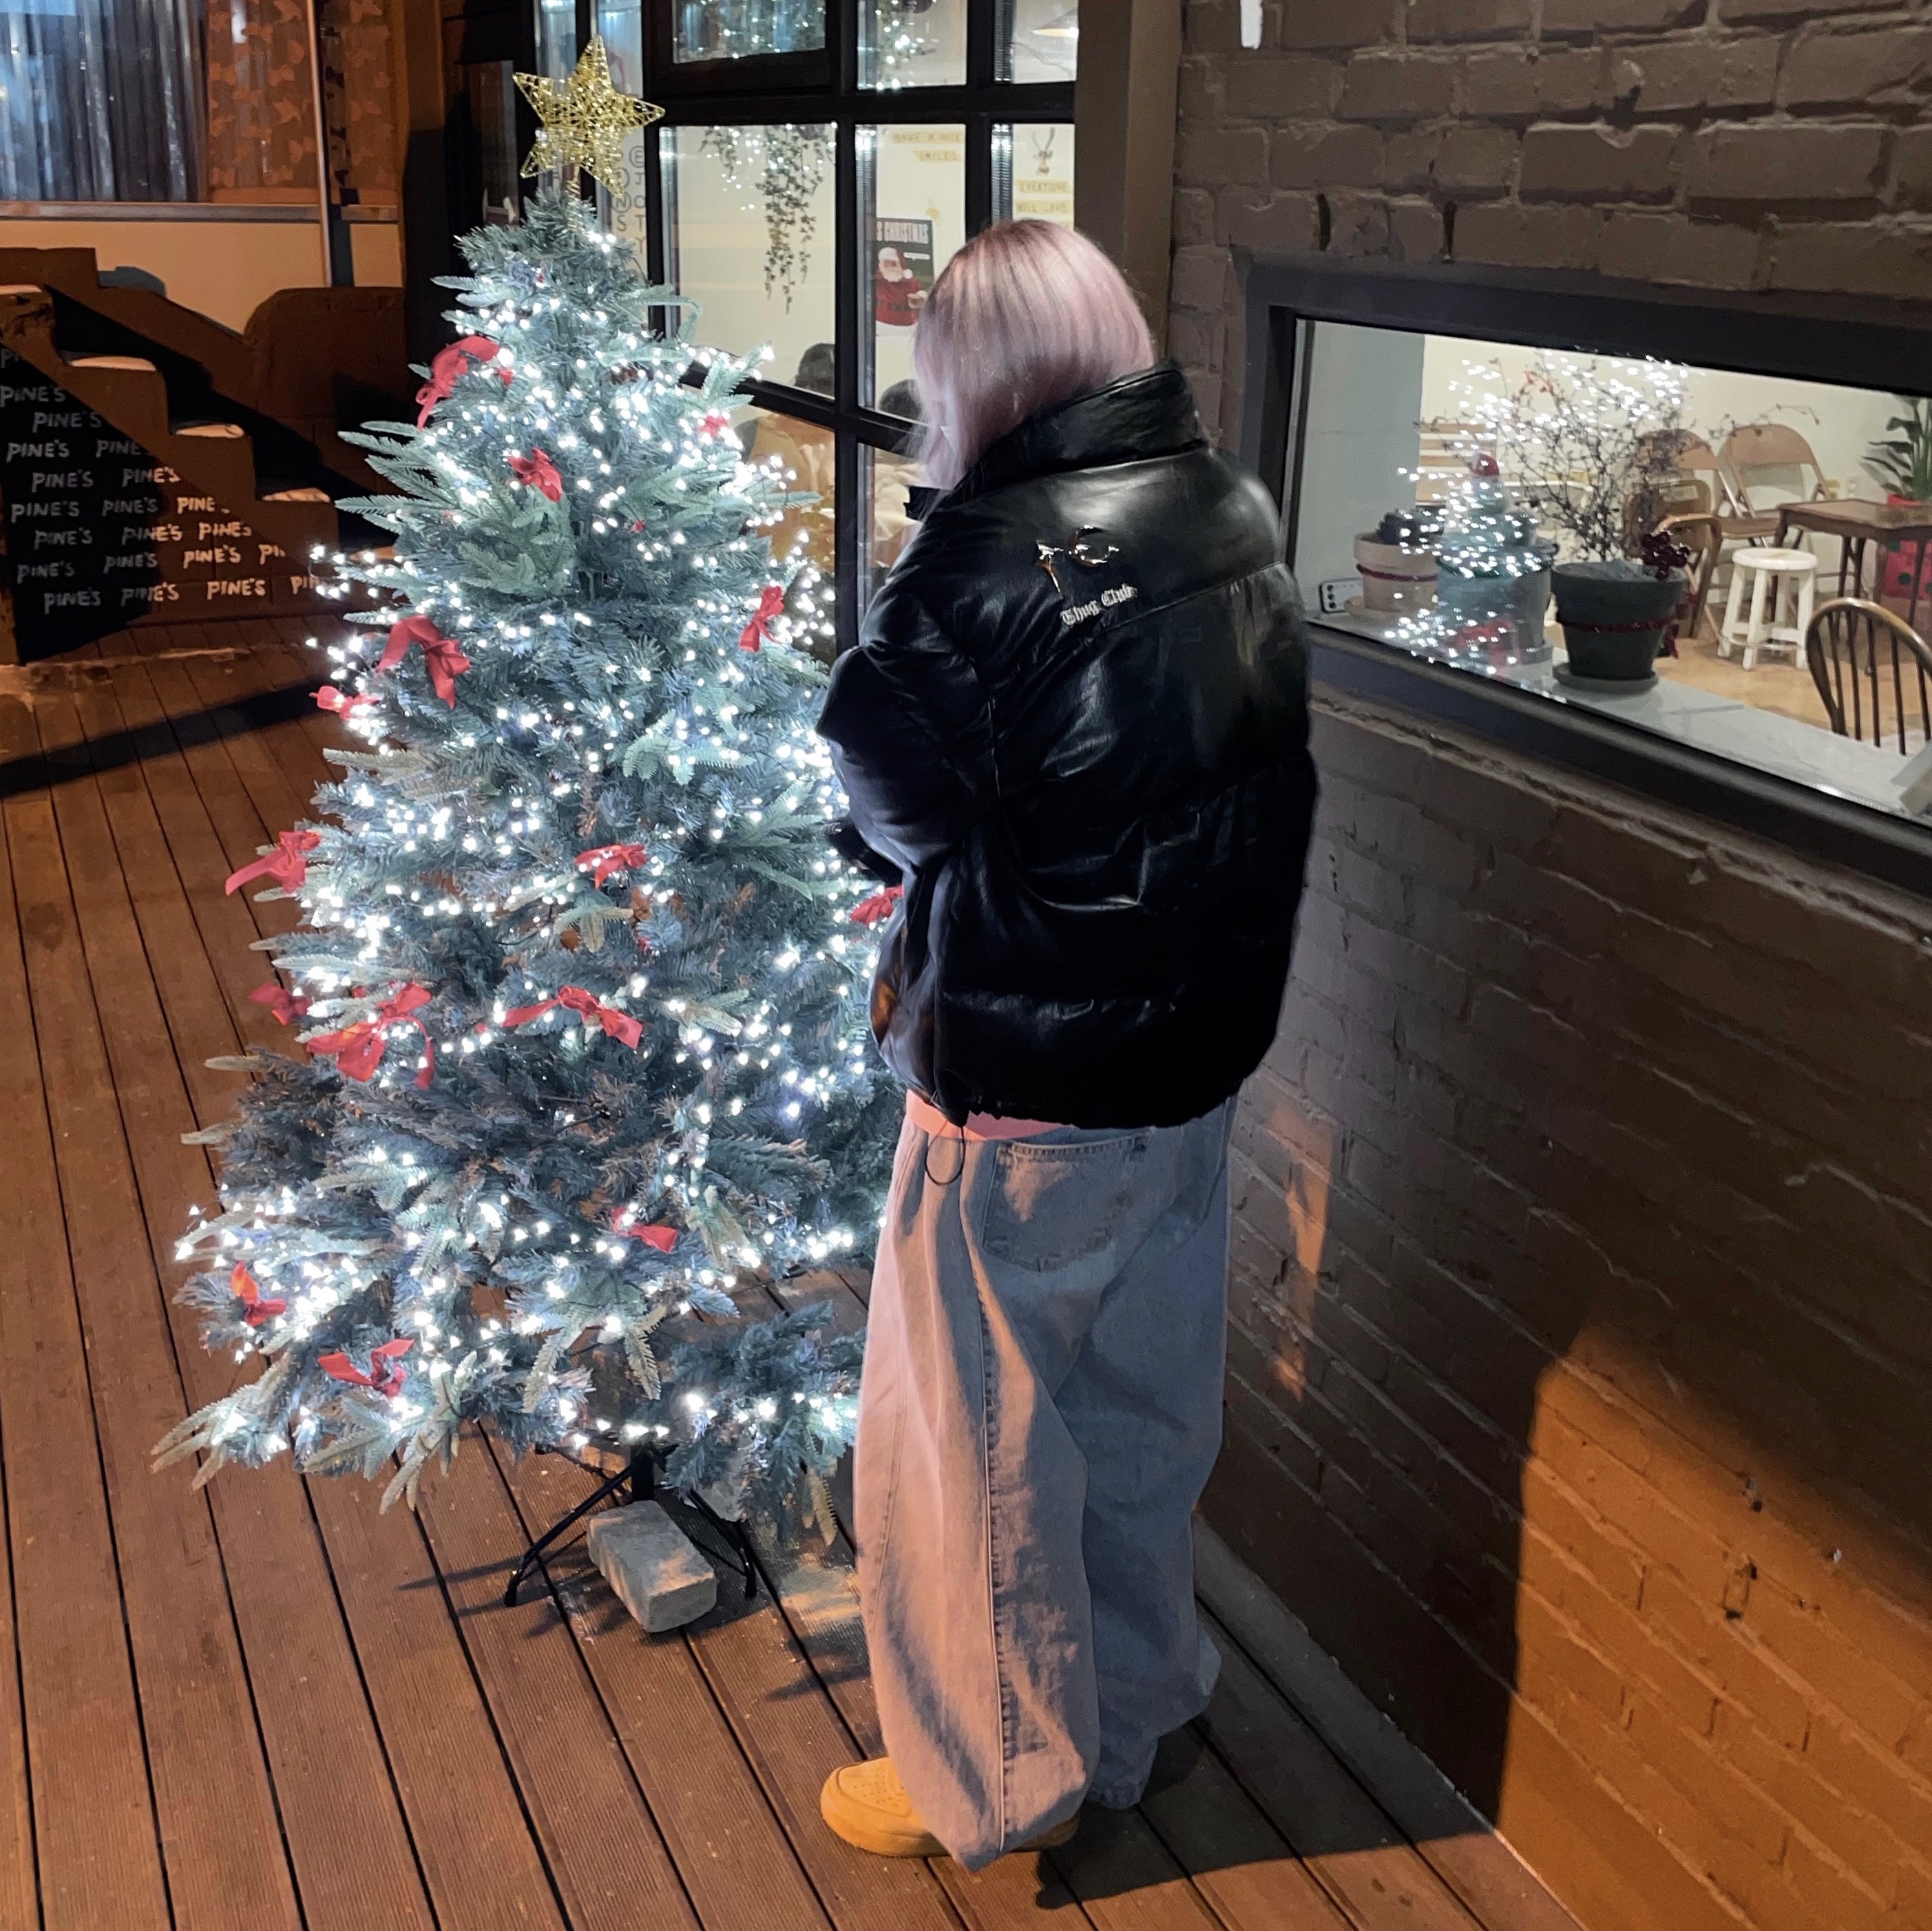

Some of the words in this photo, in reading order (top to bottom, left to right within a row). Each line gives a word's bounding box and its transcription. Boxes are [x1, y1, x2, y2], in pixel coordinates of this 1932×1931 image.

[32, 412, 102, 433] PINE'S
[6, 439, 70, 463] PINE'S
[32, 469, 93, 492] PINE'S
[11, 500, 80, 523] PINE'S
[101, 497, 158, 516] PINE'S
[34, 527, 93, 550] PINE'S
[122, 523, 182, 545] PINE'S
[17, 560, 74, 584] PINE'S
[103, 551, 158, 573] PINE'S
[182, 545, 241, 569] PINE'S
[44, 587, 101, 614] PINE'S
[120, 582, 179, 606] PINE'S
[207, 578, 266, 600] PINE'S
[1060, 600, 1101, 626] Thug
[1101, 582, 1138, 607] Club
